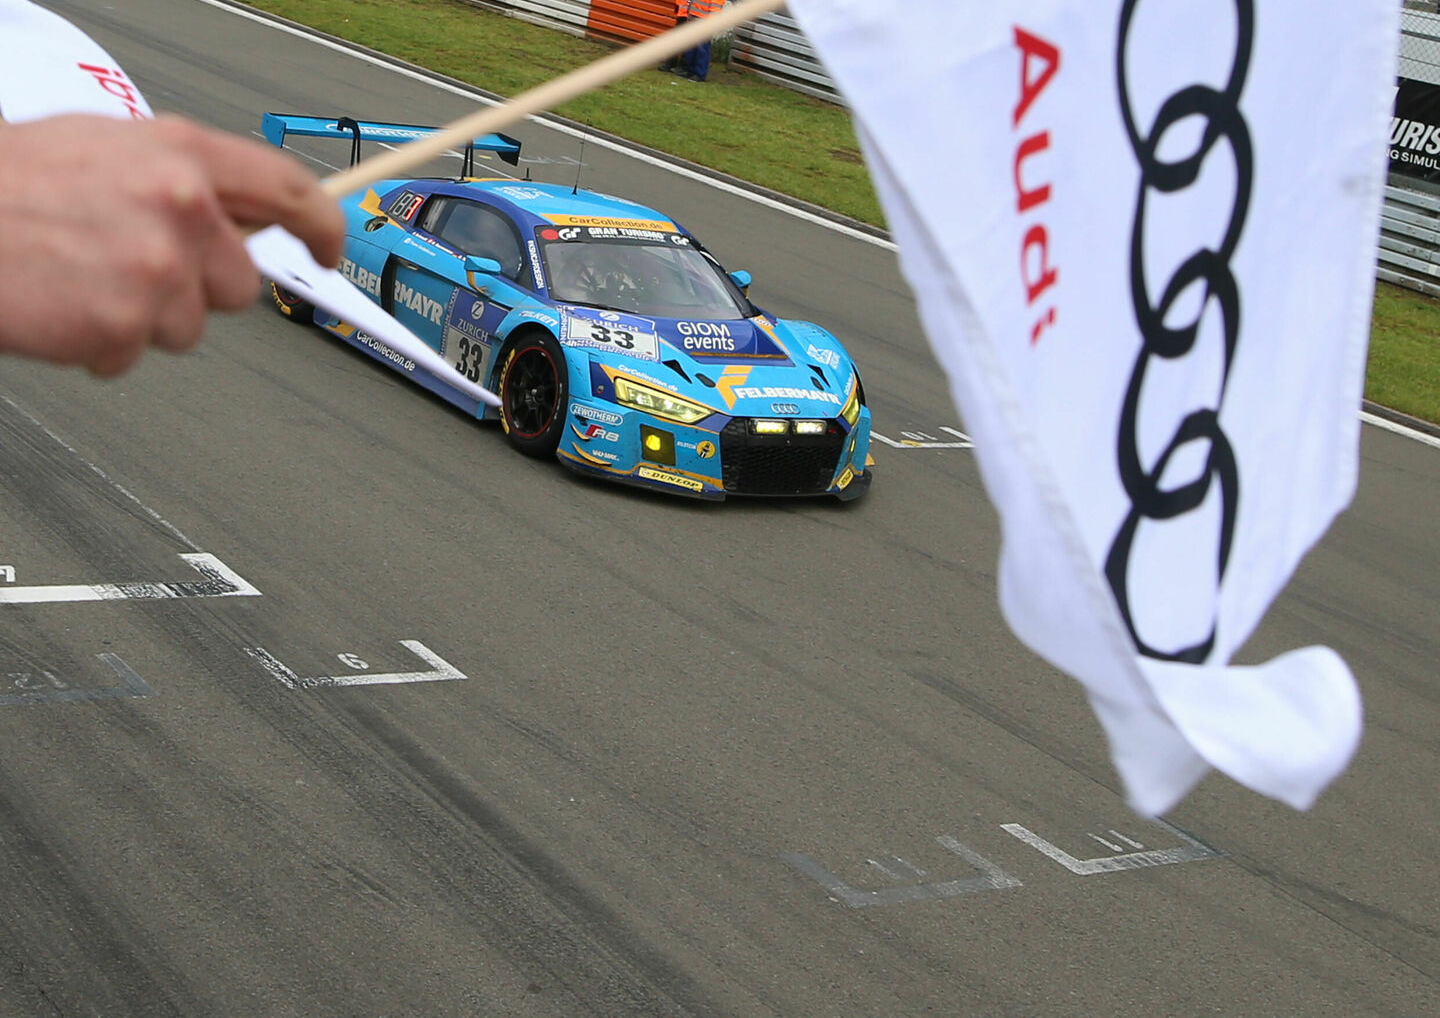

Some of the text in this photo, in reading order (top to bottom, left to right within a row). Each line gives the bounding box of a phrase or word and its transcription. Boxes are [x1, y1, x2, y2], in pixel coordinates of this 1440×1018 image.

[1011, 24, 1062, 348] Audi
[457, 318, 489, 343] ZURICH
[591, 324, 635, 350] 33
[677, 321, 731, 337] GIOM
[683, 335, 735, 352] events
[456, 337, 483, 383] 33
[617, 363, 679, 392] CarCollection.de
[734, 386, 842, 406] FELBERMAYR
[572, 404, 619, 424] ZEWOTHERM
[651, 471, 699, 489] DUNLOP
